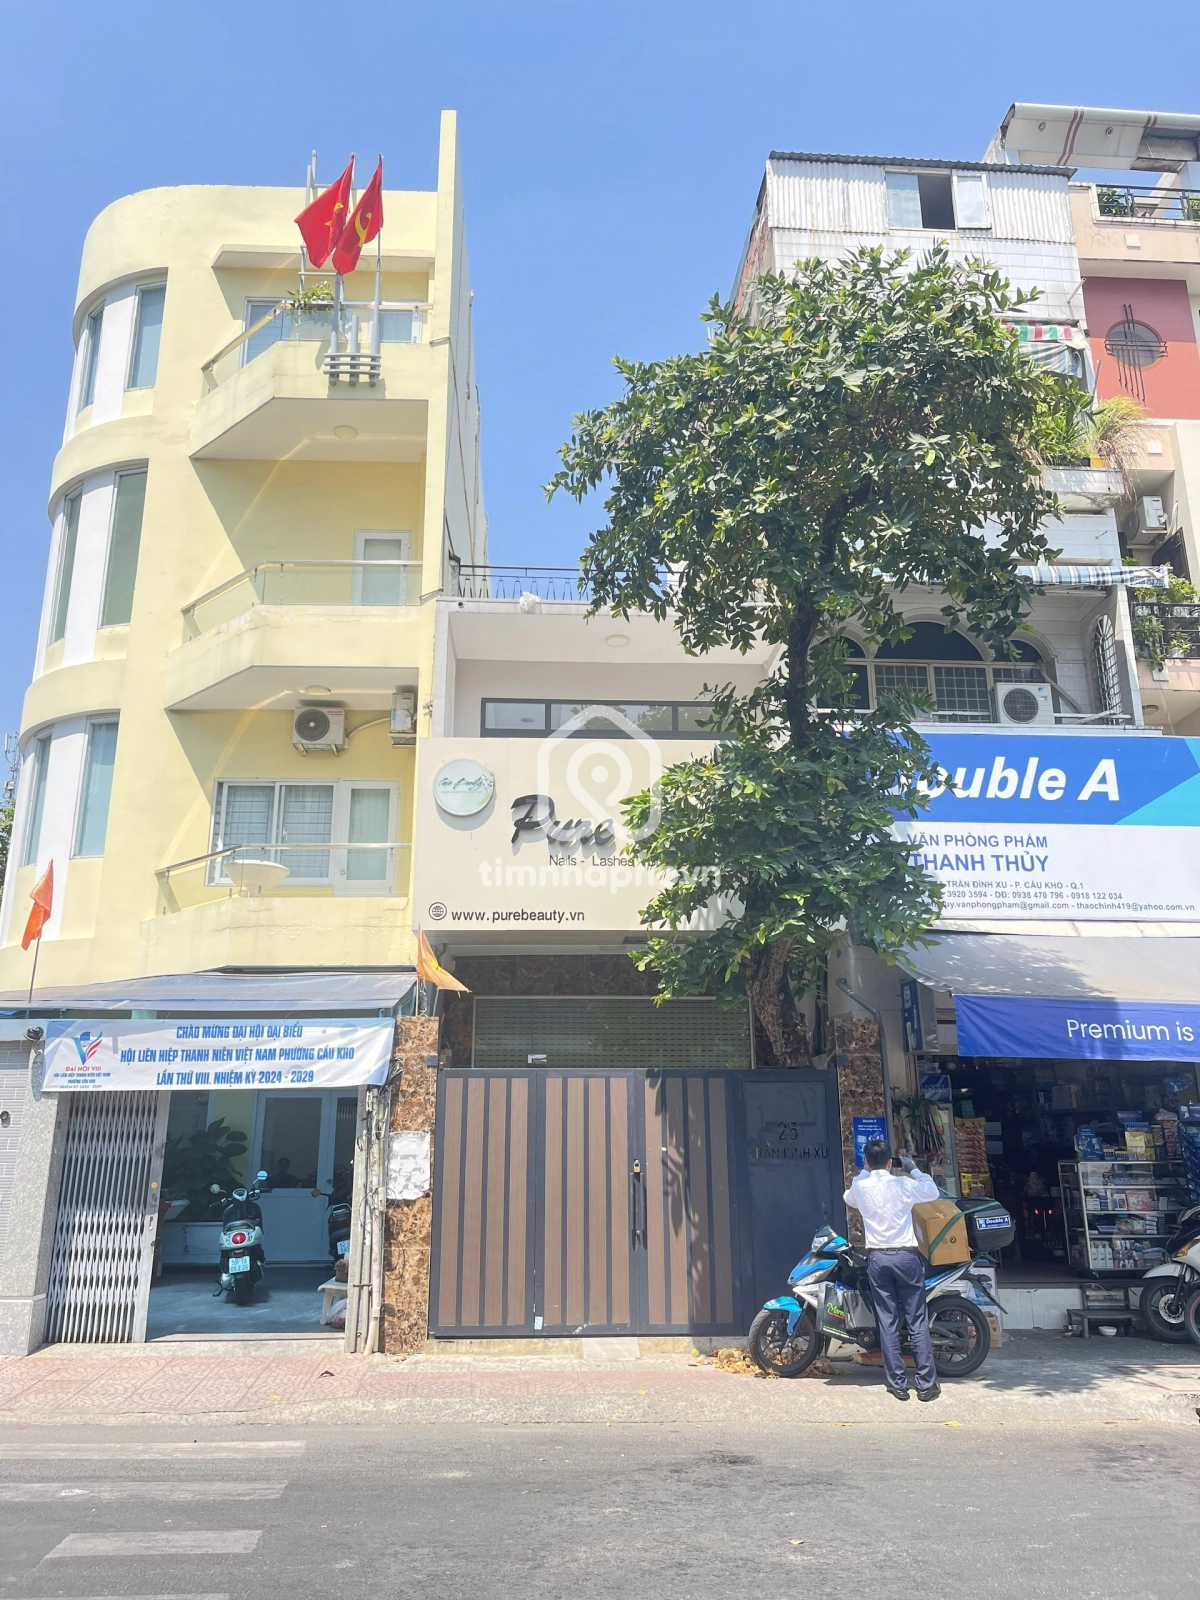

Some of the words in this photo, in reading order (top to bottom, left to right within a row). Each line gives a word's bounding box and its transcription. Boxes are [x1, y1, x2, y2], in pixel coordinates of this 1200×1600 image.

[897, 756, 1066, 801] ouble
[1076, 758, 1120, 801] A
[511, 794, 615, 847] Pure
[944, 832, 999, 848] PHÒNG
[549, 855, 577, 867] Nails
[911, 853, 986, 871] THANH
[990, 851, 1049, 872] THỦY
[995, 880, 1008, 889] XU
[1044, 882, 1064, 890] KHO
[1070, 882, 1084, 890] Q.1
[946, 890, 966, 898] 3920
[968, 890, 987, 898] 3594
[1012, 891, 1031, 899] 0938
[1033, 891, 1047, 899] 470
[1050, 891, 1065, 900] 796
[1070, 892, 1090, 900] 0918
[1093, 892, 1107, 900] 122
[1108, 892, 1123, 900] 034
[176, 1024, 200, 1039] CHÀO
[232, 1025, 247, 1041] ĐẠI
[248, 1024, 264, 1041] HỘI
[266, 1025, 281, 1040] ĐẠI
[1066, 1019, 1171, 1041] Premium
[1175, 1021, 1195, 1042] is
[120, 1047, 136, 1066] HỘI
[137, 1047, 157, 1063] LIÊN
[158, 1047, 179, 1066] HIỆP
[180, 1049, 210, 1062] THANH
[211, 1047, 234, 1062] NIÊN
[235, 1046, 254, 1064] VIỆT
[254, 1048, 277, 1061] NAM
[336, 1047, 355, 1060] KHO
[258, 1071, 283, 1084] 2024
[290, 1070, 315, 1083] 2029
[777, 1121, 799, 1141] 25
[813, 1147, 829, 1159] XU
